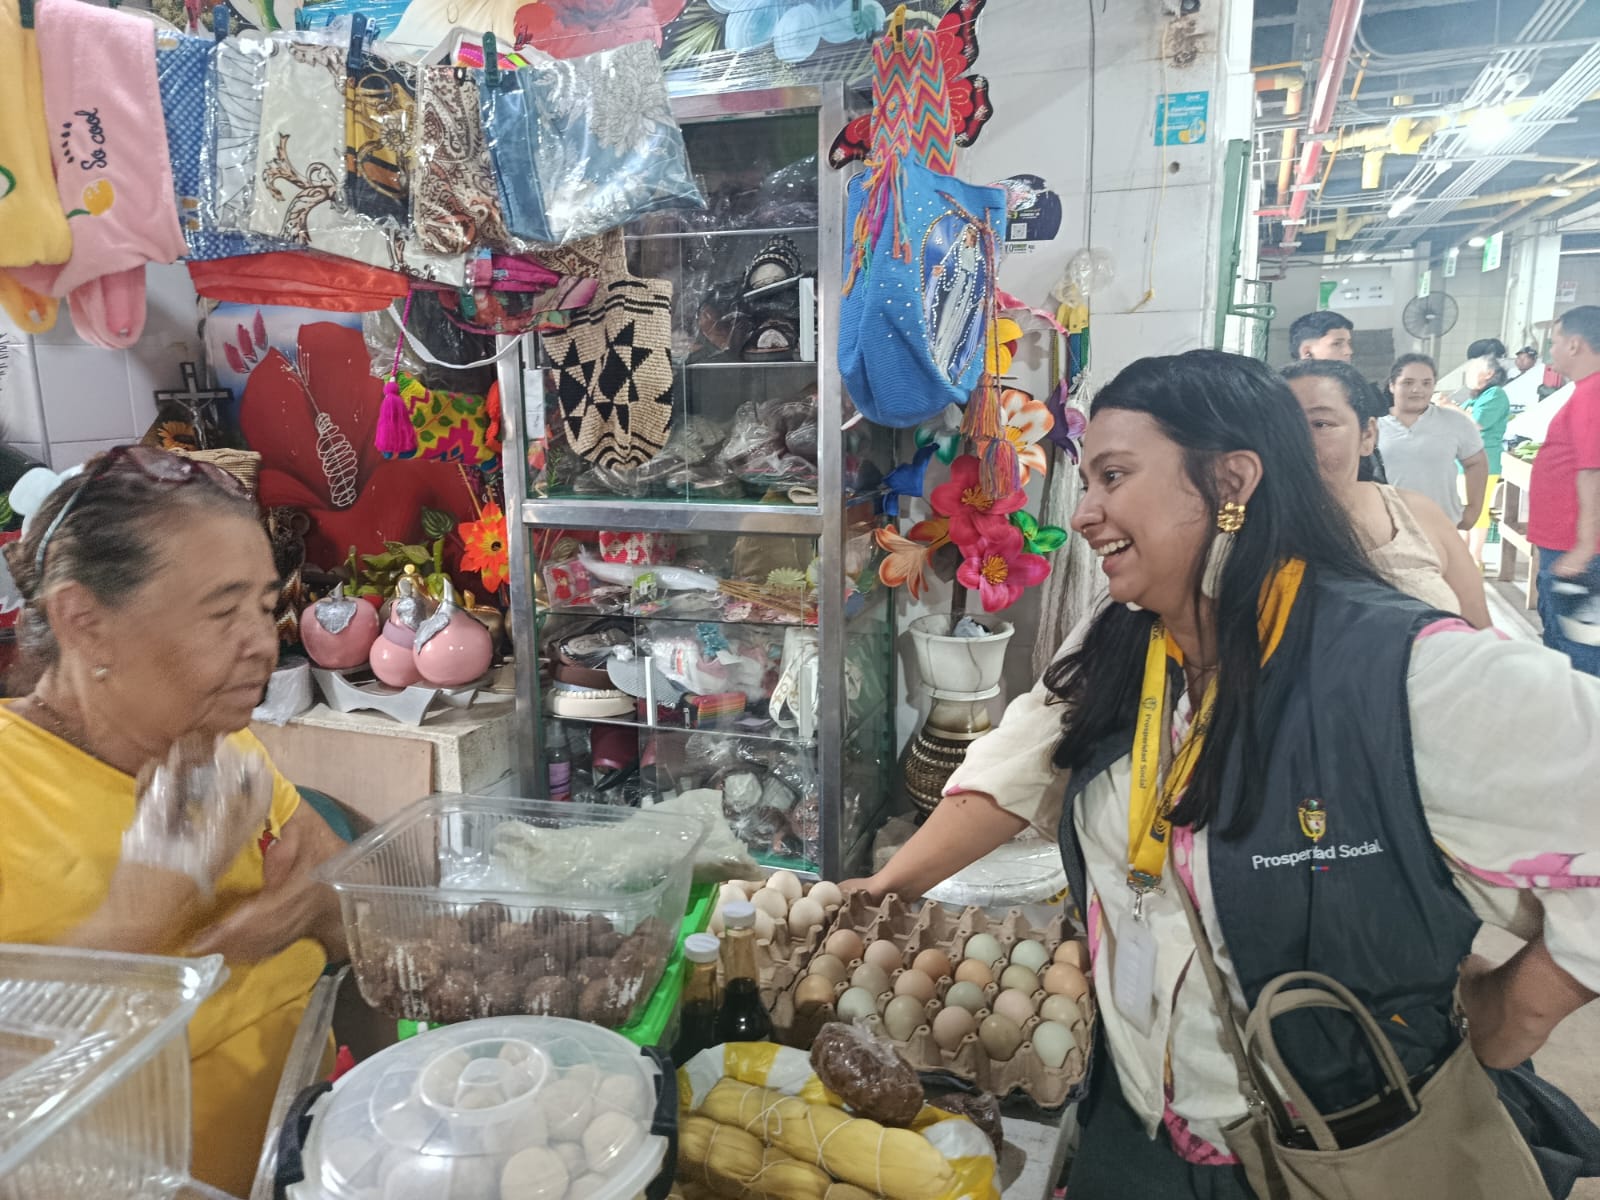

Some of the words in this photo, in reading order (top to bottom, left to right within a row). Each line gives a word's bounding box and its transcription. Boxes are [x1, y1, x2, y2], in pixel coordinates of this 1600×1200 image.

[74, 107, 105, 145] cool
[80, 148, 107, 170] So
[1140, 713, 1152, 763] Prosperidad
[1139, 764, 1148, 789] Social
[1252, 846, 1336, 869] Prosperad
[1339, 839, 1383, 858] Social
